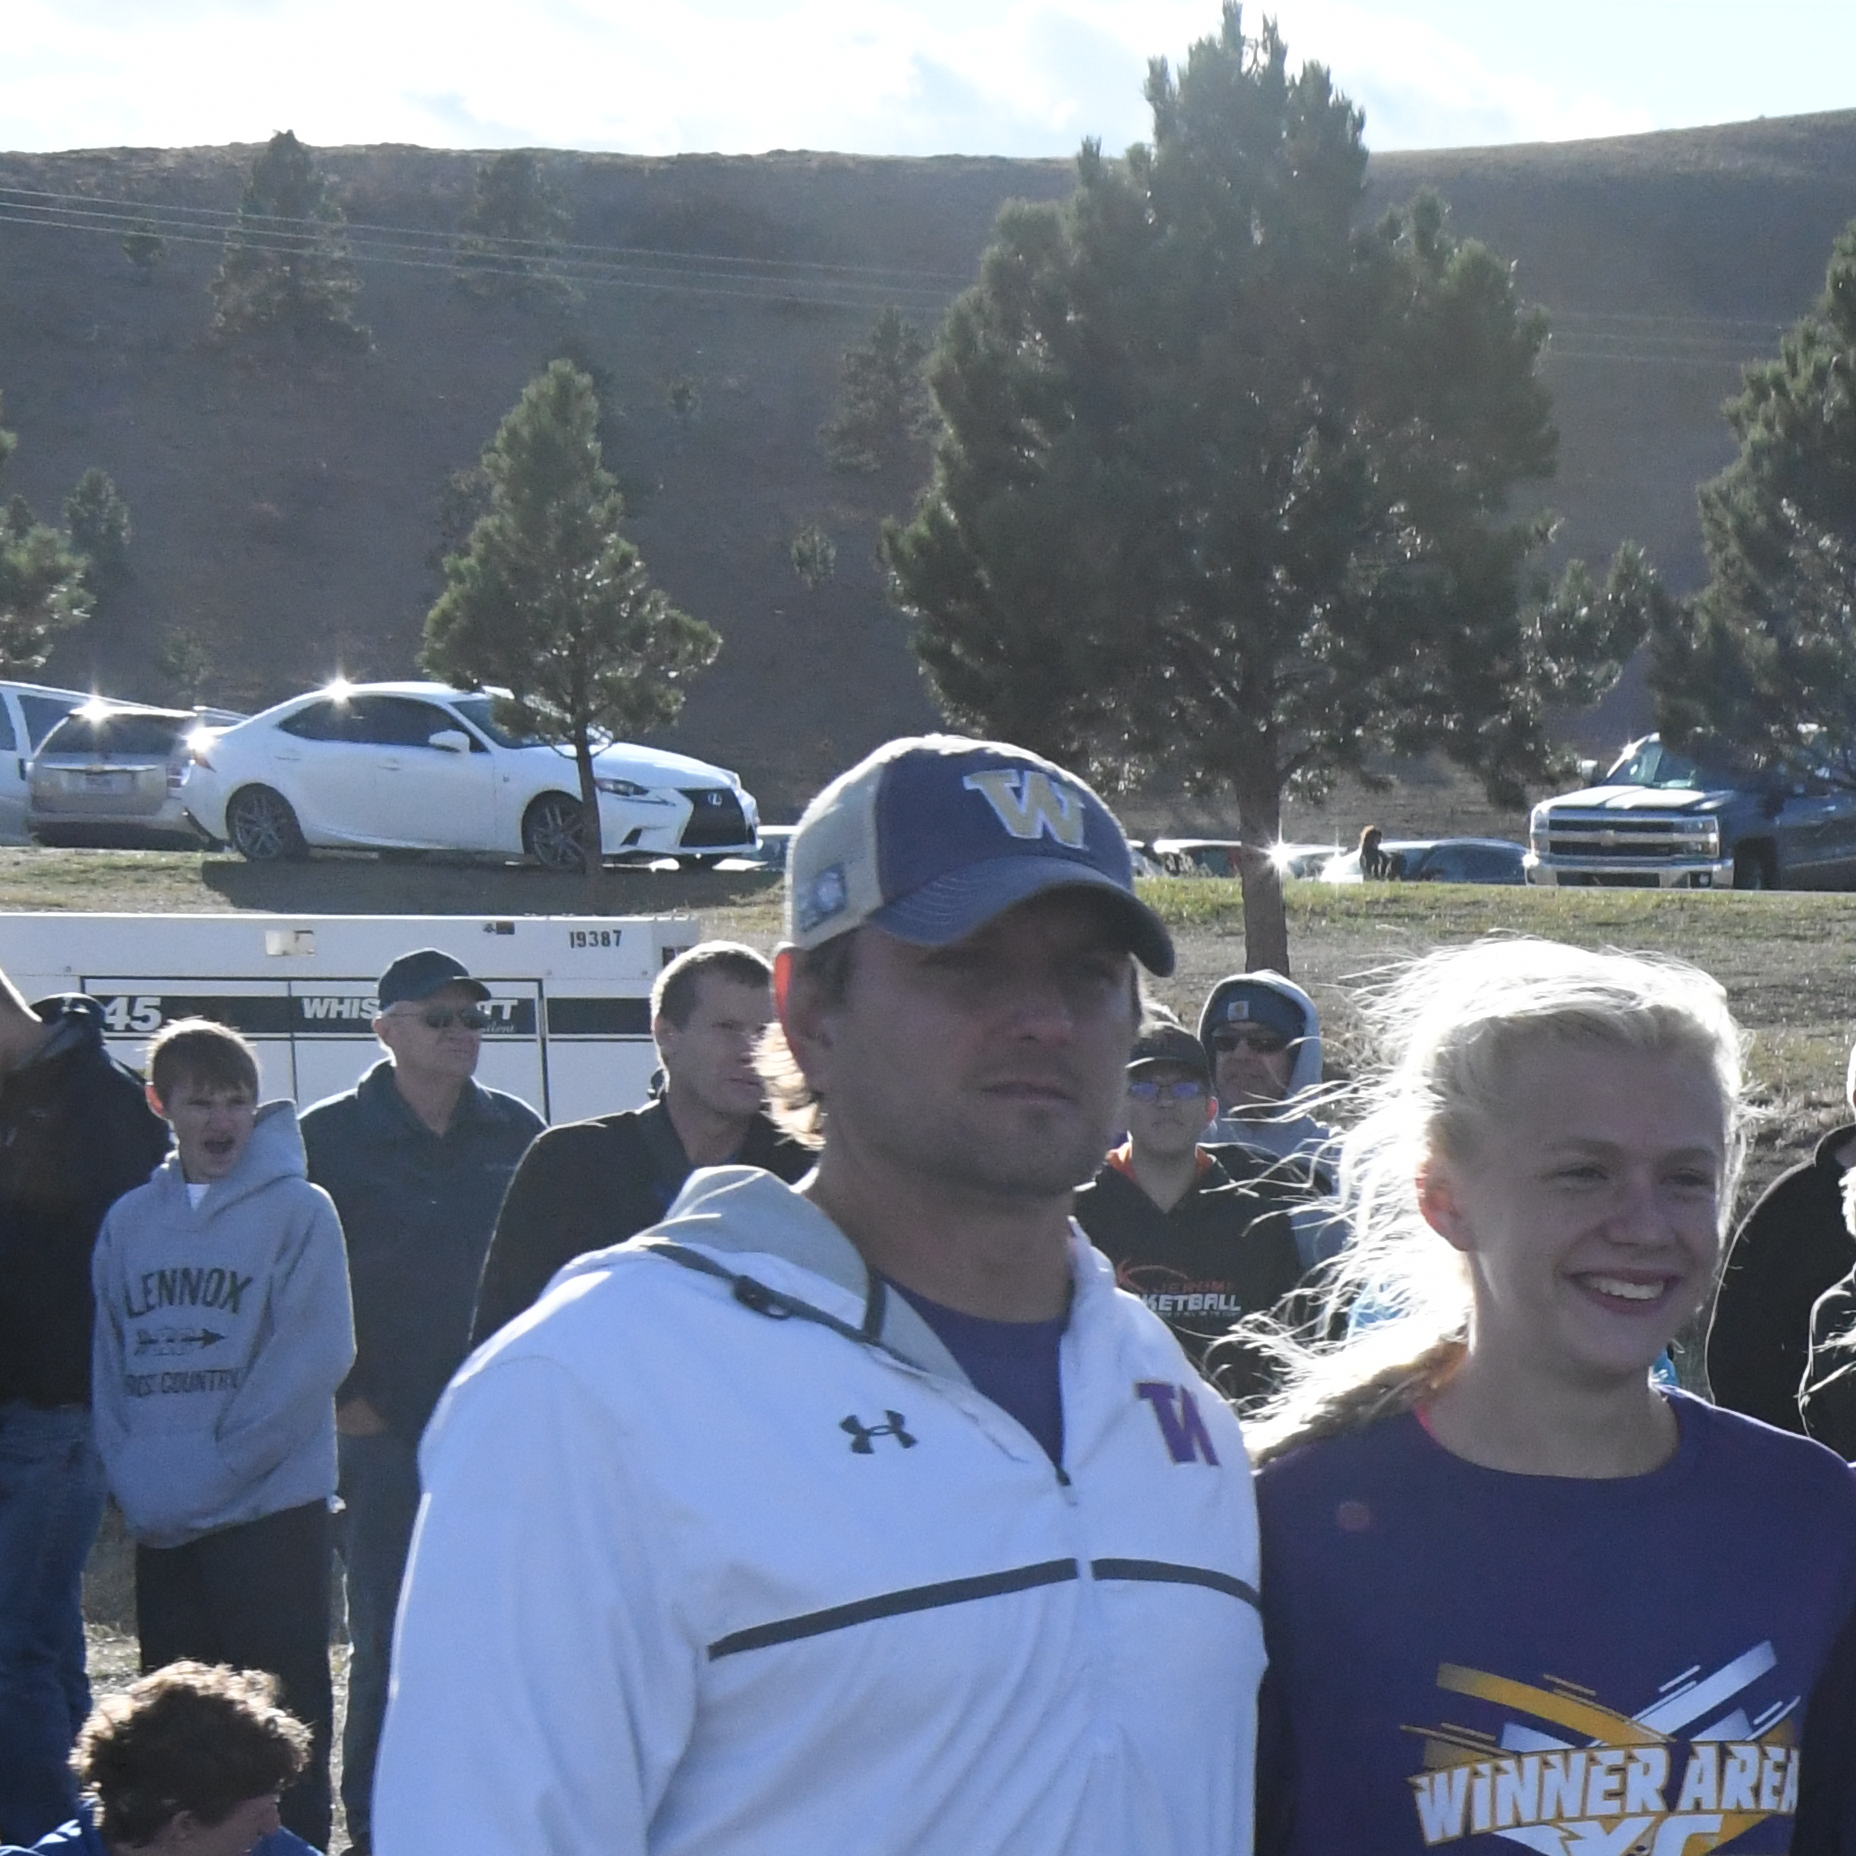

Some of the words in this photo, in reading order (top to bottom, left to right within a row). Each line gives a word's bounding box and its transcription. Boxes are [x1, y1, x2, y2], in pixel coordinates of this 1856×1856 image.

[569, 929, 623, 950] 19387
[123, 1267, 254, 1319] LENNOX
[1142, 1292, 1241, 1311] KETBALL
[1409, 1745, 1671, 1846] WINNER
[1677, 1741, 1800, 1817] AREA
